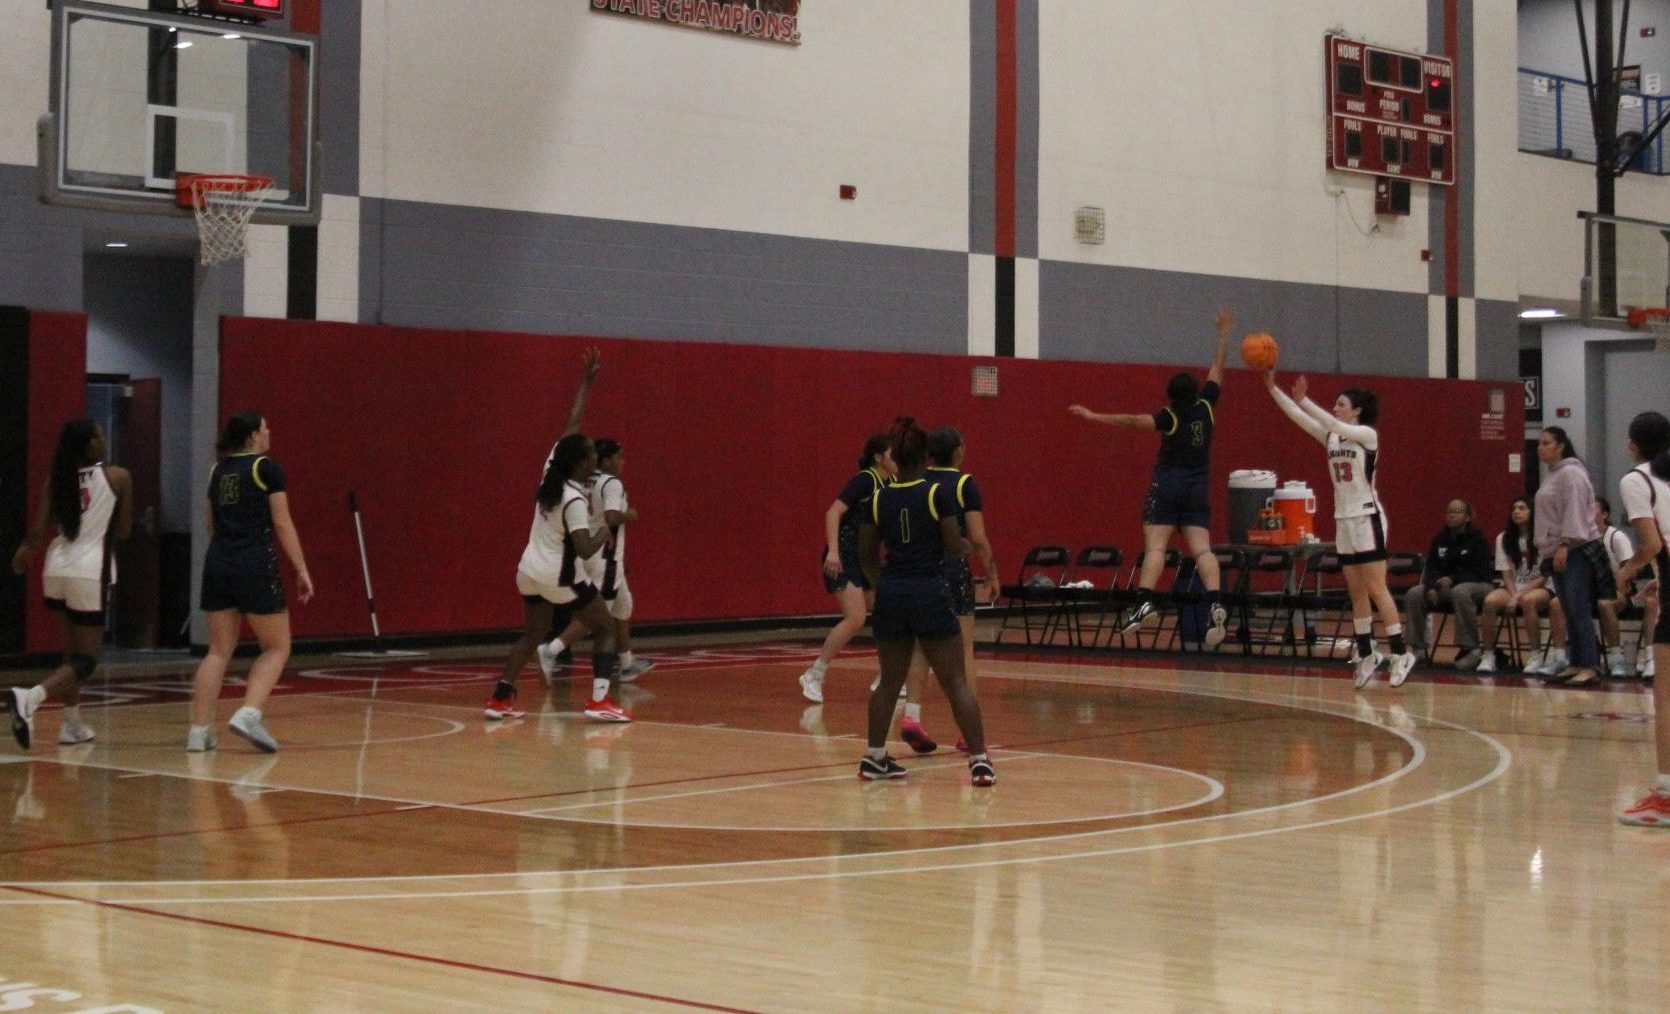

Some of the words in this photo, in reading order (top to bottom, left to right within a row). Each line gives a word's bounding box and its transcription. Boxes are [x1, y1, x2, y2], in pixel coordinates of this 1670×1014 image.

[1338, 44, 1360, 60] HOME
[1424, 61, 1450, 78] VISITOR
[1379, 99, 1399, 112] PERIOD
[1333, 462, 1352, 483] 13
[900, 508, 910, 543] 1
